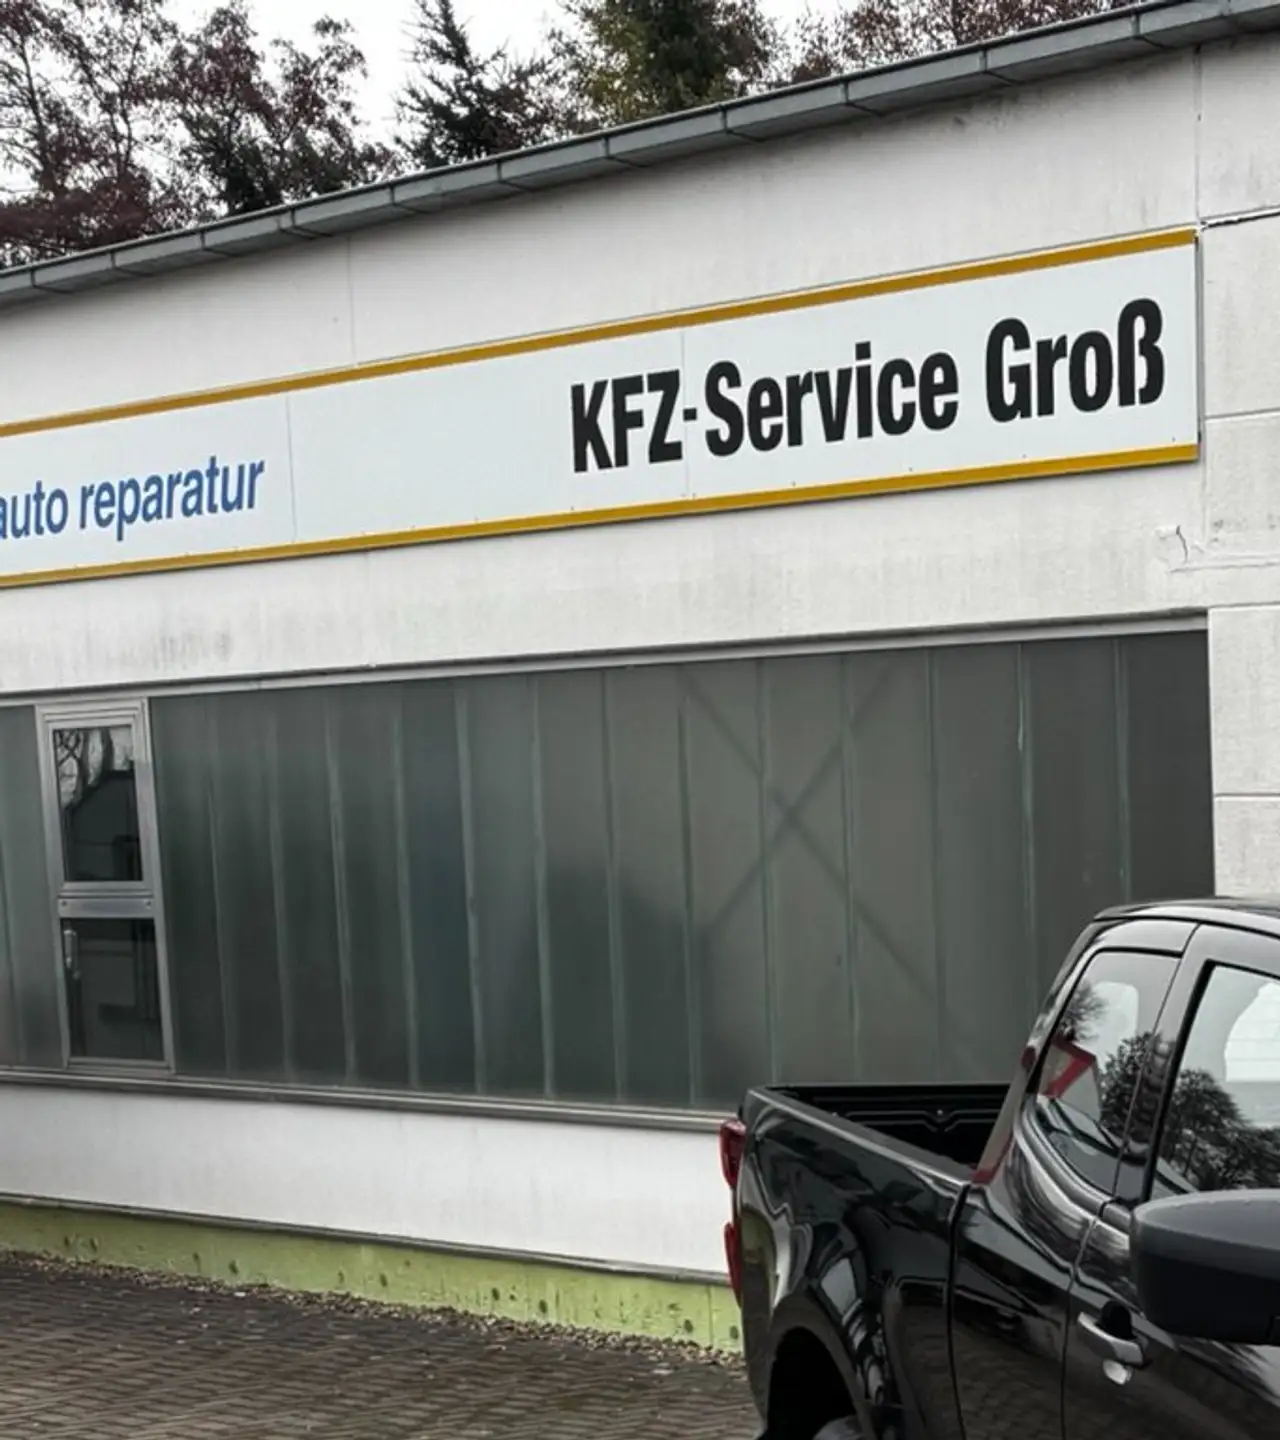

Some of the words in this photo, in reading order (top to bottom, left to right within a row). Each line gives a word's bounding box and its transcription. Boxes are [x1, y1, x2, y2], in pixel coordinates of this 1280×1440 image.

[571, 341, 959, 474] KFZ-Service
[985, 297, 1165, 424] Groß
[79, 455, 266, 542] reparatur
